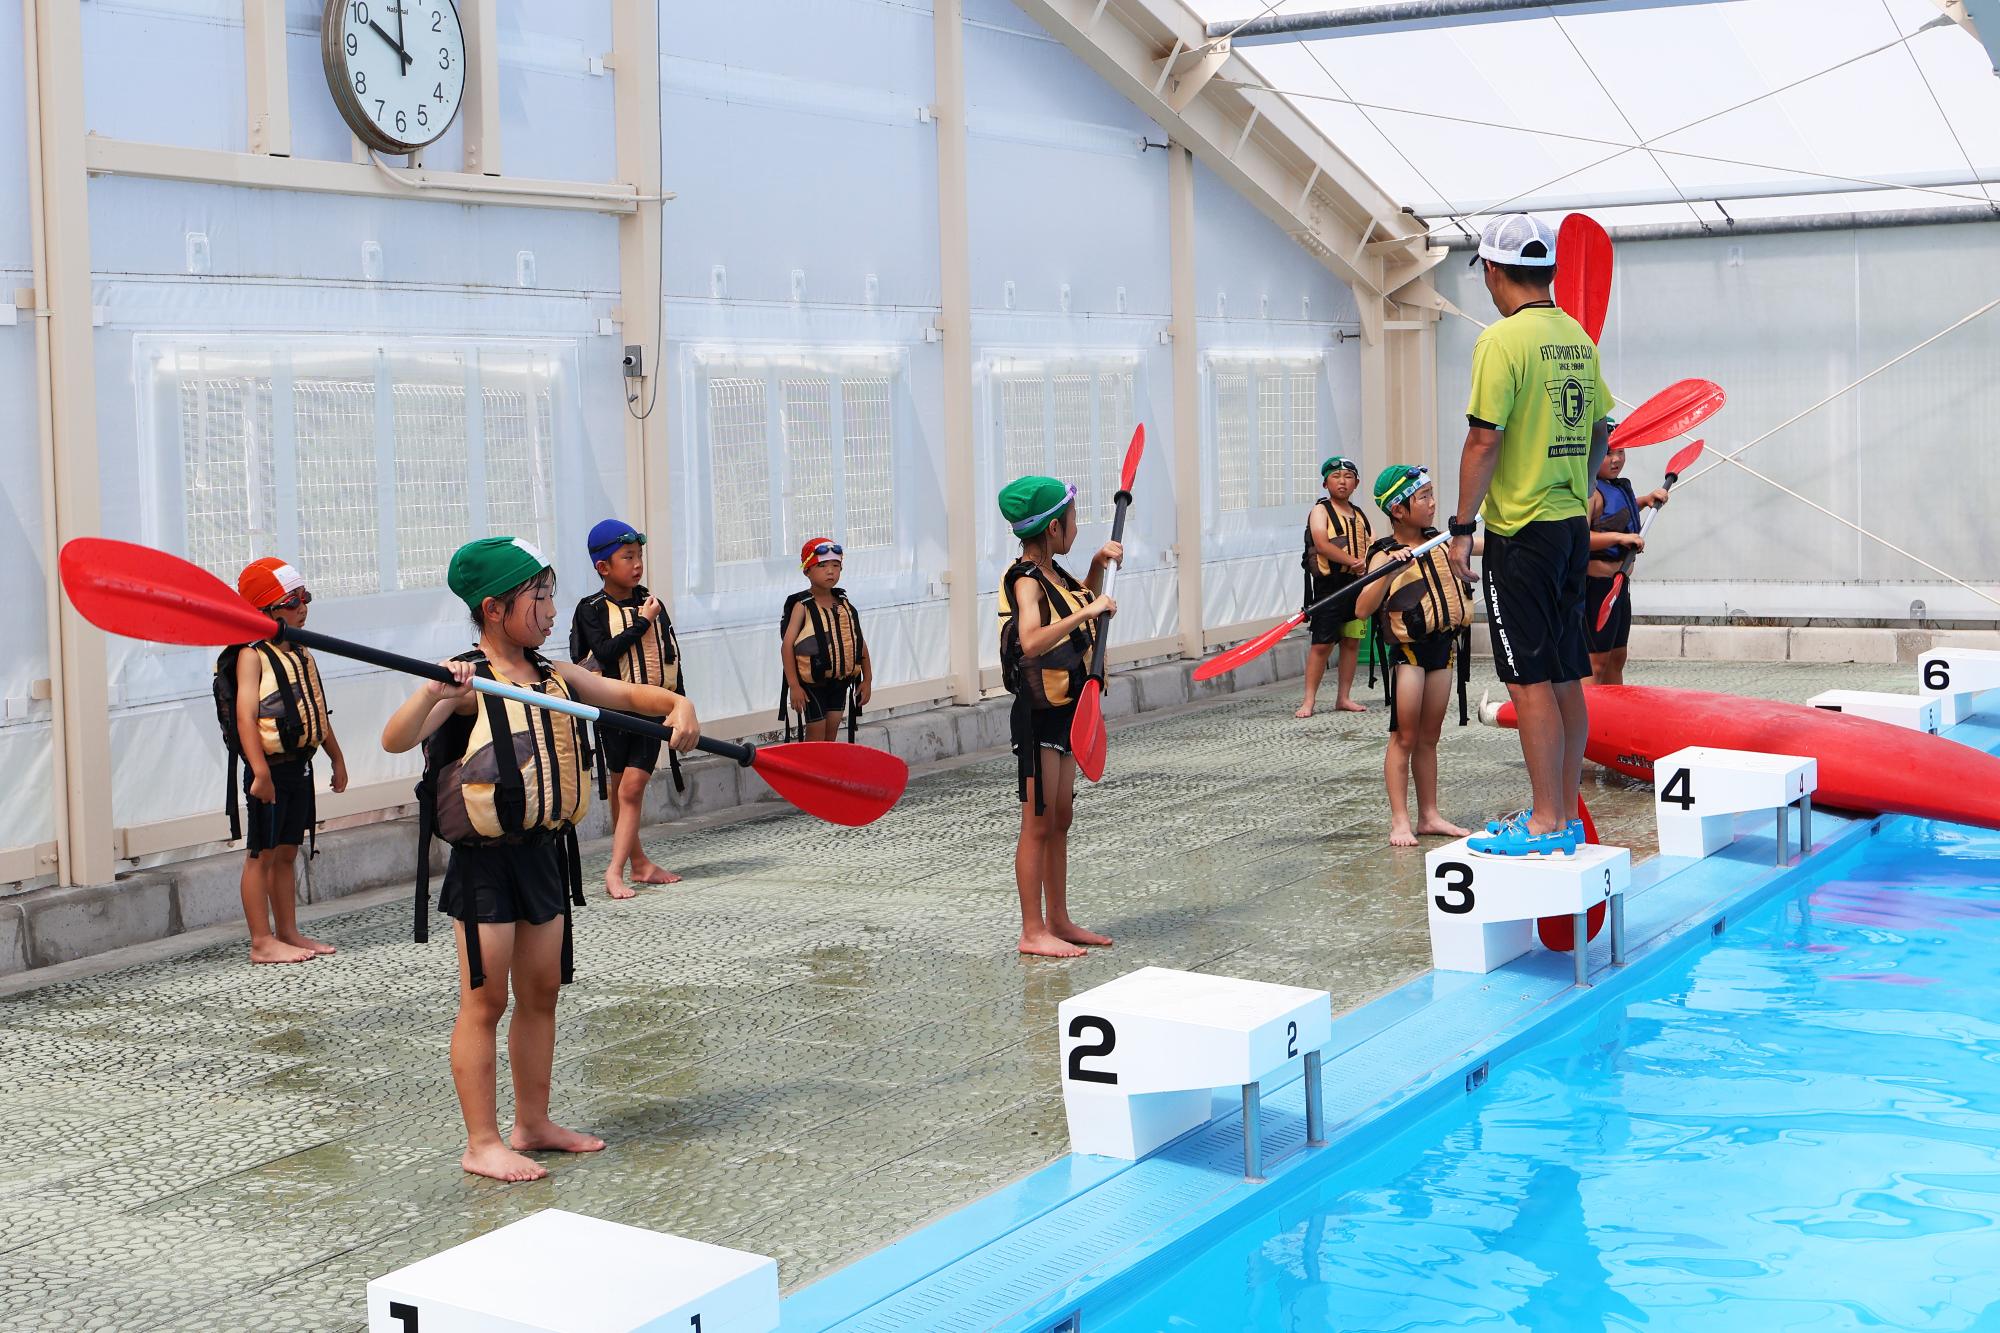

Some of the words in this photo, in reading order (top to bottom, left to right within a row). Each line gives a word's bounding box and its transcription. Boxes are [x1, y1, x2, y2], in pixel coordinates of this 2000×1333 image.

[349, 1, 369, 25] 10
[386, 5, 409, 16] Natinal
[431, 10, 442, 33] 2
[346, 32, 358, 57] 9
[438, 47, 450, 71] 3
[354, 71, 367, 95] 8
[432, 82, 444, 104] 4
[374, 98, 386, 122] 7
[395, 110, 407, 133] 6
[417, 104, 428, 127] 5
[1924, 660, 1950, 690] 6
[1660, 768, 1696, 810] 4
[1798, 773, 1804, 795] 4
[1435, 862, 1475, 914] 3
[1604, 868, 1611, 897] 3
[1068, 1016, 1118, 1084] 2
[1287, 1021, 1298, 1058] 2
